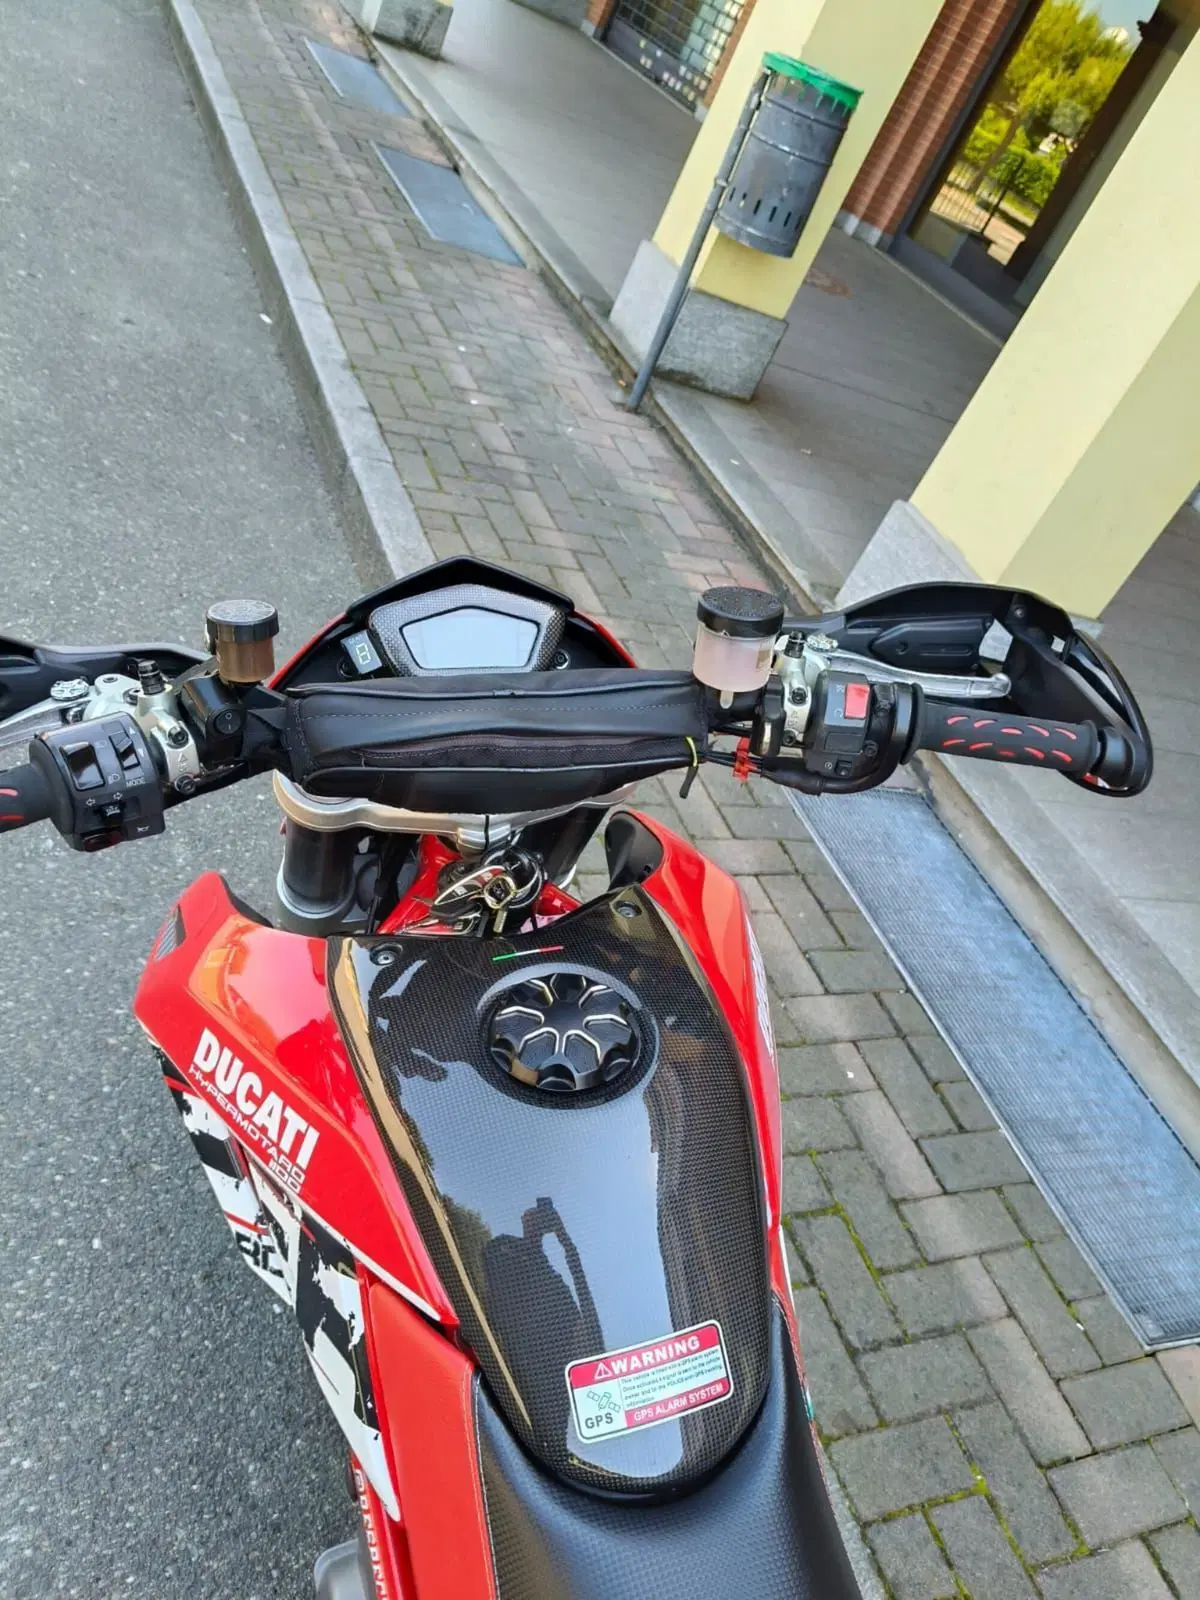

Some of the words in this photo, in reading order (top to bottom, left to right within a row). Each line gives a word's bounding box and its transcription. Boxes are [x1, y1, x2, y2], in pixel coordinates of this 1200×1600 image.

[193, 1027, 320, 1170] DUCATI
[188, 1064, 306, 1185] HYPERMOTARD
[611, 1336, 700, 1375] WARNING
[585, 1412, 614, 1429] GPS
[634, 1405, 654, 1422] GPS
[655, 1396, 687, 1416] ALARM
[689, 1382, 724, 1404] SYSTEM
